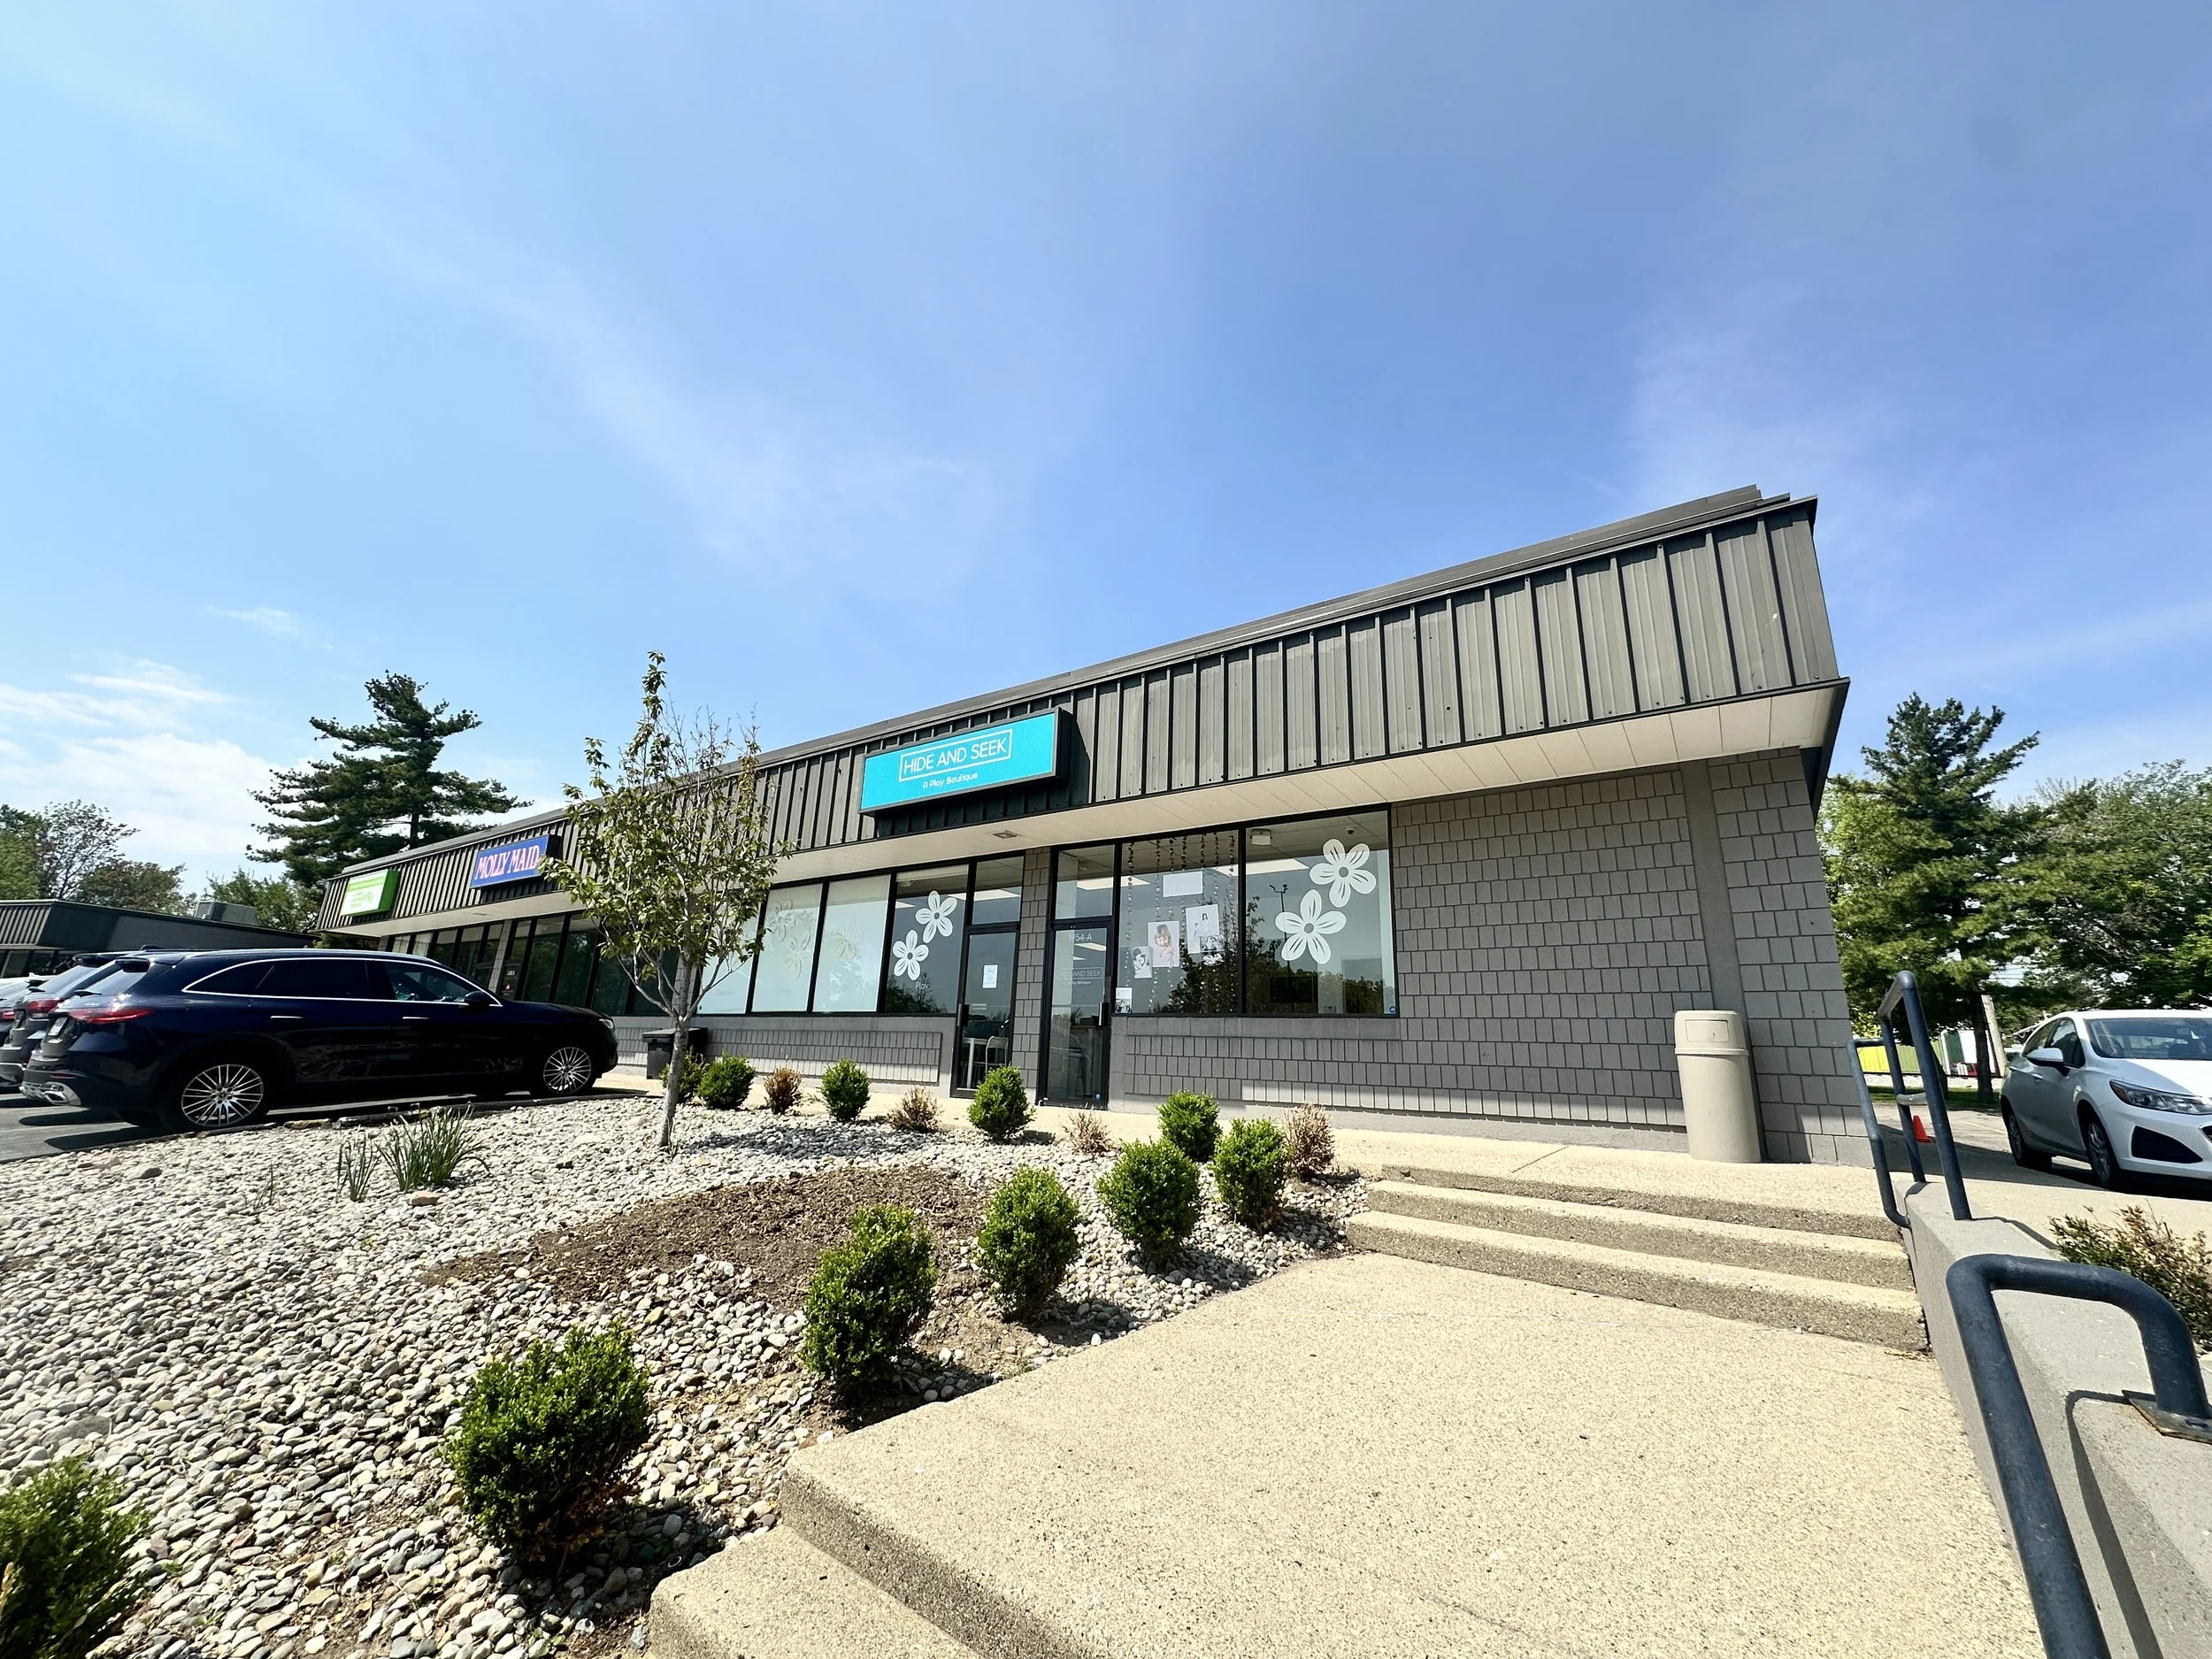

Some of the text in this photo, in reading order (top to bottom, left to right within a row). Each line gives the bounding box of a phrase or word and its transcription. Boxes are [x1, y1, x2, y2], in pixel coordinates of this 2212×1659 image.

[904, 738, 1006, 773] HIDE AND SEEK
[929, 779, 945, 789] Play
[947, 772, 978, 784] Boutique
[475, 846, 540, 879] MOLLY MAID
[915, 981, 929, 991] Play
